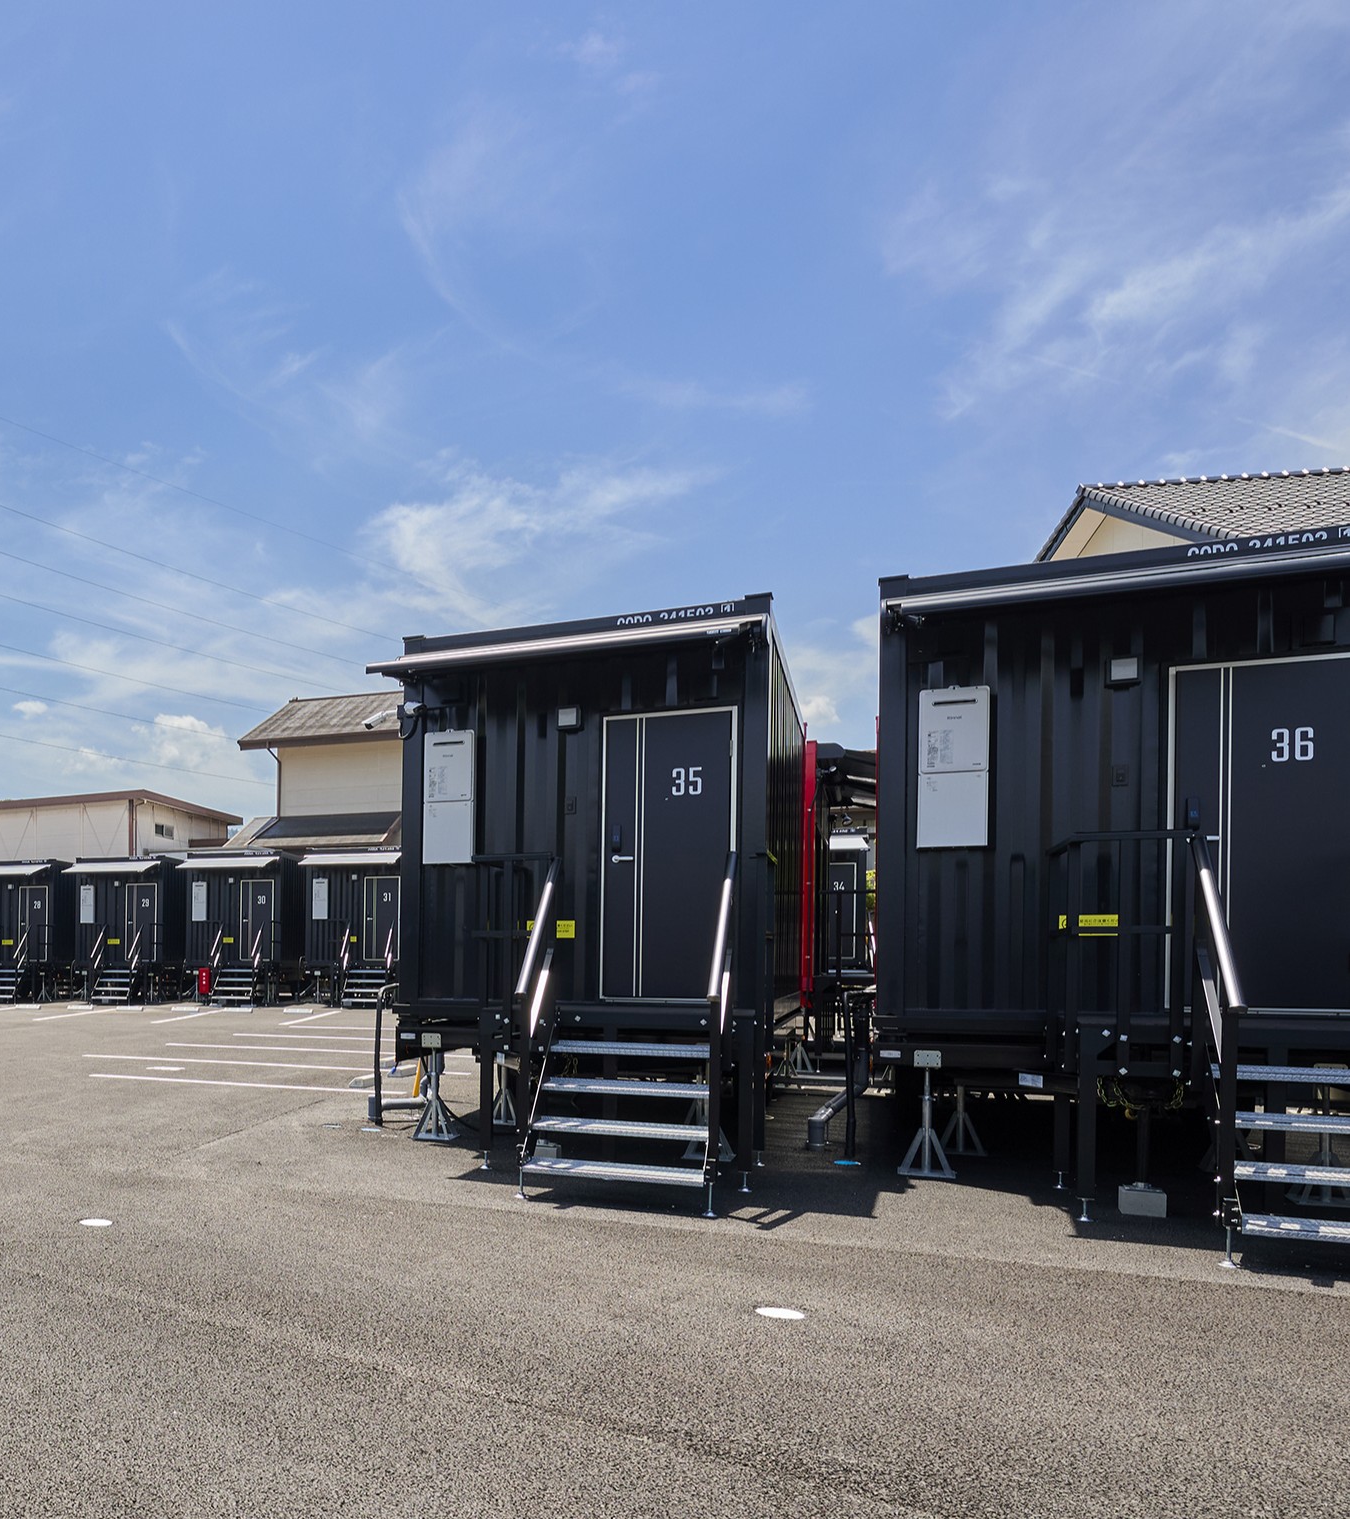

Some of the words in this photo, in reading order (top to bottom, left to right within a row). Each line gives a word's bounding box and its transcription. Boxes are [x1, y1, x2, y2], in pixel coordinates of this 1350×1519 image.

[1271, 726, 1314, 761] 36
[671, 766, 703, 796] 35
[833, 881, 845, 891] 34
[257, 895, 266, 905] 30
[382, 892, 392, 902] 31
[33, 900, 42, 910] 28
[141, 898, 150, 908] 29
